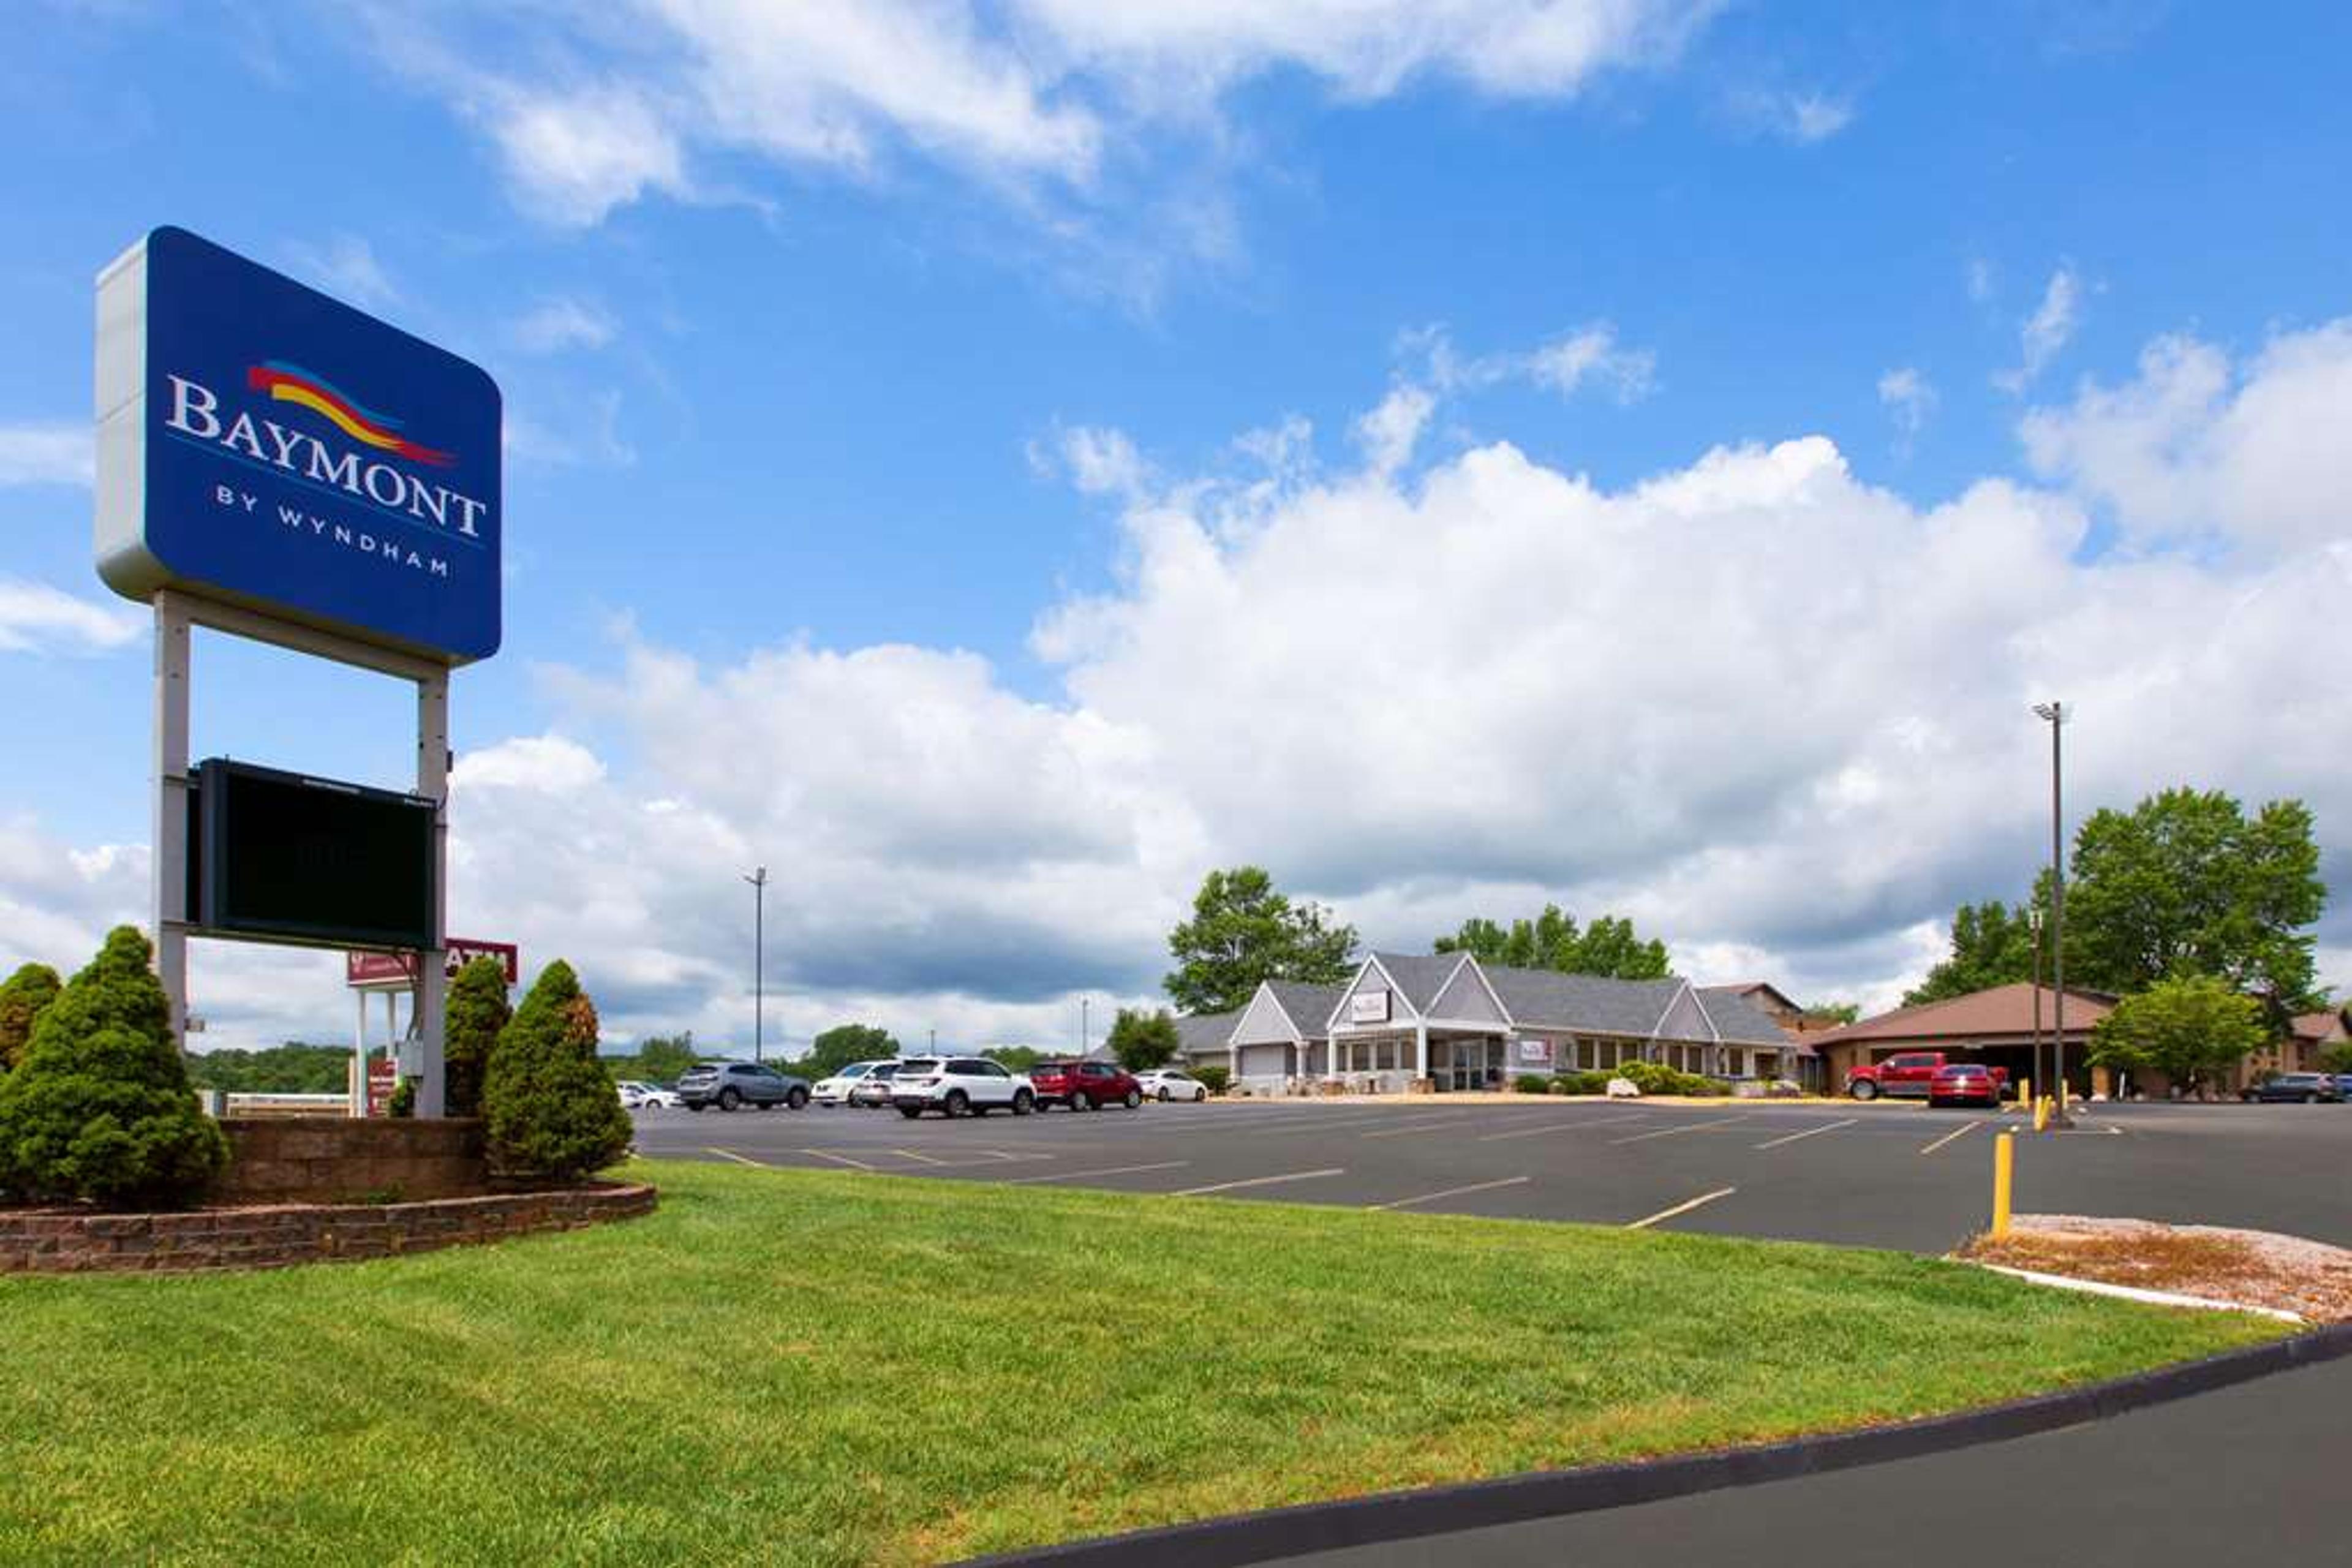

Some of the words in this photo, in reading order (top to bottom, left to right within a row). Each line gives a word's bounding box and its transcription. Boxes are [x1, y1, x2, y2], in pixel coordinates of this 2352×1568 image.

[166, 374, 486, 538] BAYMONT
[216, 485, 258, 512] BY
[277, 505, 448, 576] WYNDHAM
